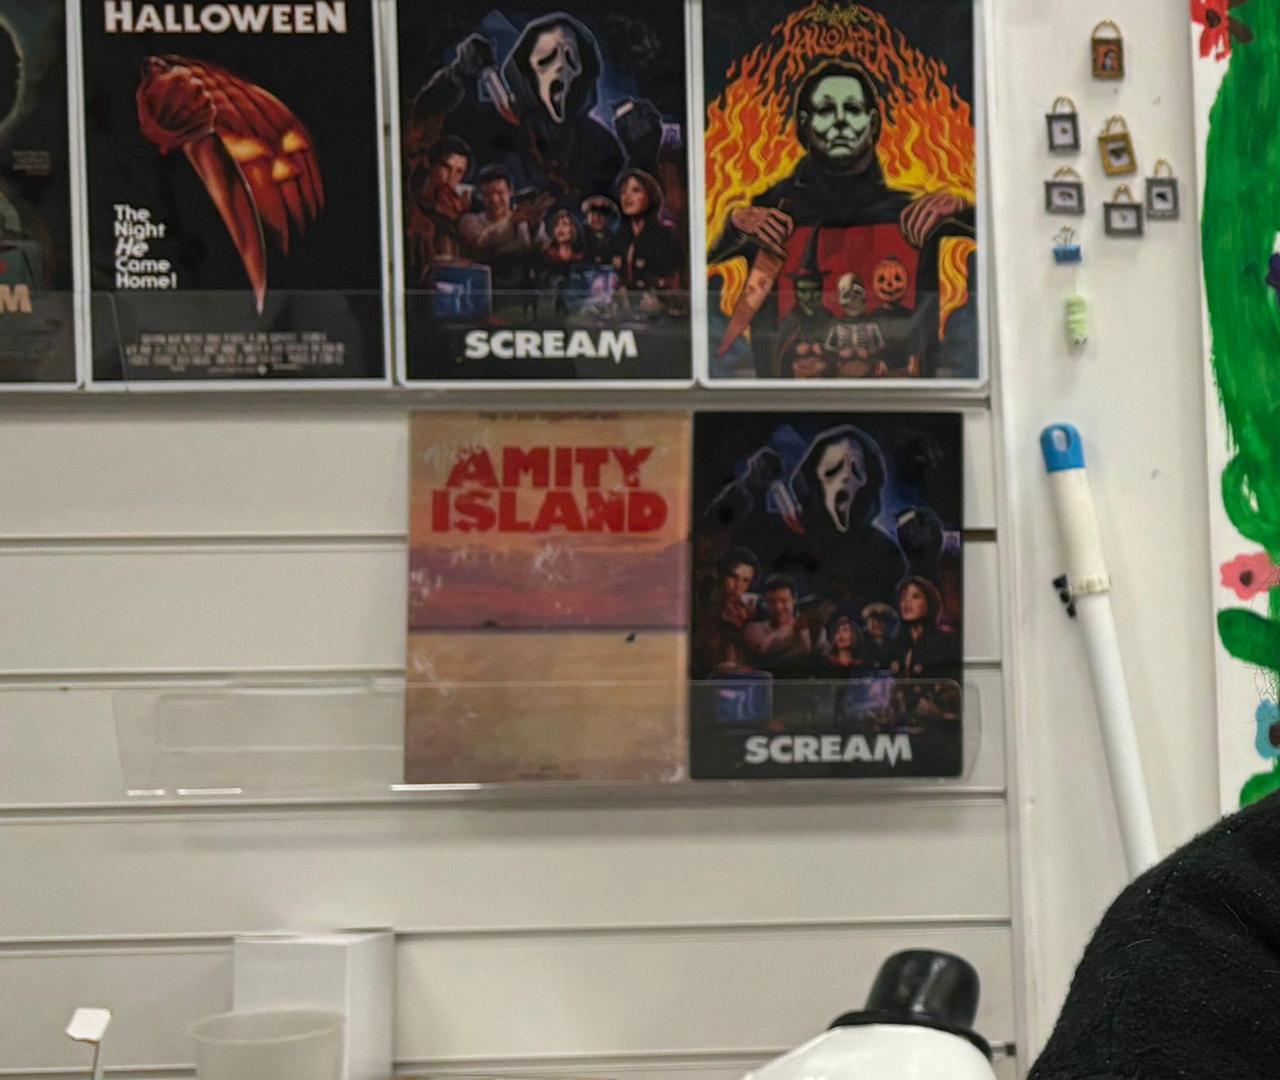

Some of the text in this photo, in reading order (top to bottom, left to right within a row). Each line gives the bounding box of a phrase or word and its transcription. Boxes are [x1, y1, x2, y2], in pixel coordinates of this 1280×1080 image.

[105, 0, 348, 33] HALLOWEEN
[113, 204, 151, 221] The
[114, 221, 166, 241] Night
[115, 238, 150, 257] He
[115, 257, 171, 273] Came
[115, 271, 178, 289] Home!
[465, 330, 639, 364] SCREAM
[446, 446, 654, 488] AMITY
[432, 489, 668, 533] ISLAND
[745, 734, 913, 767] SCREAM
